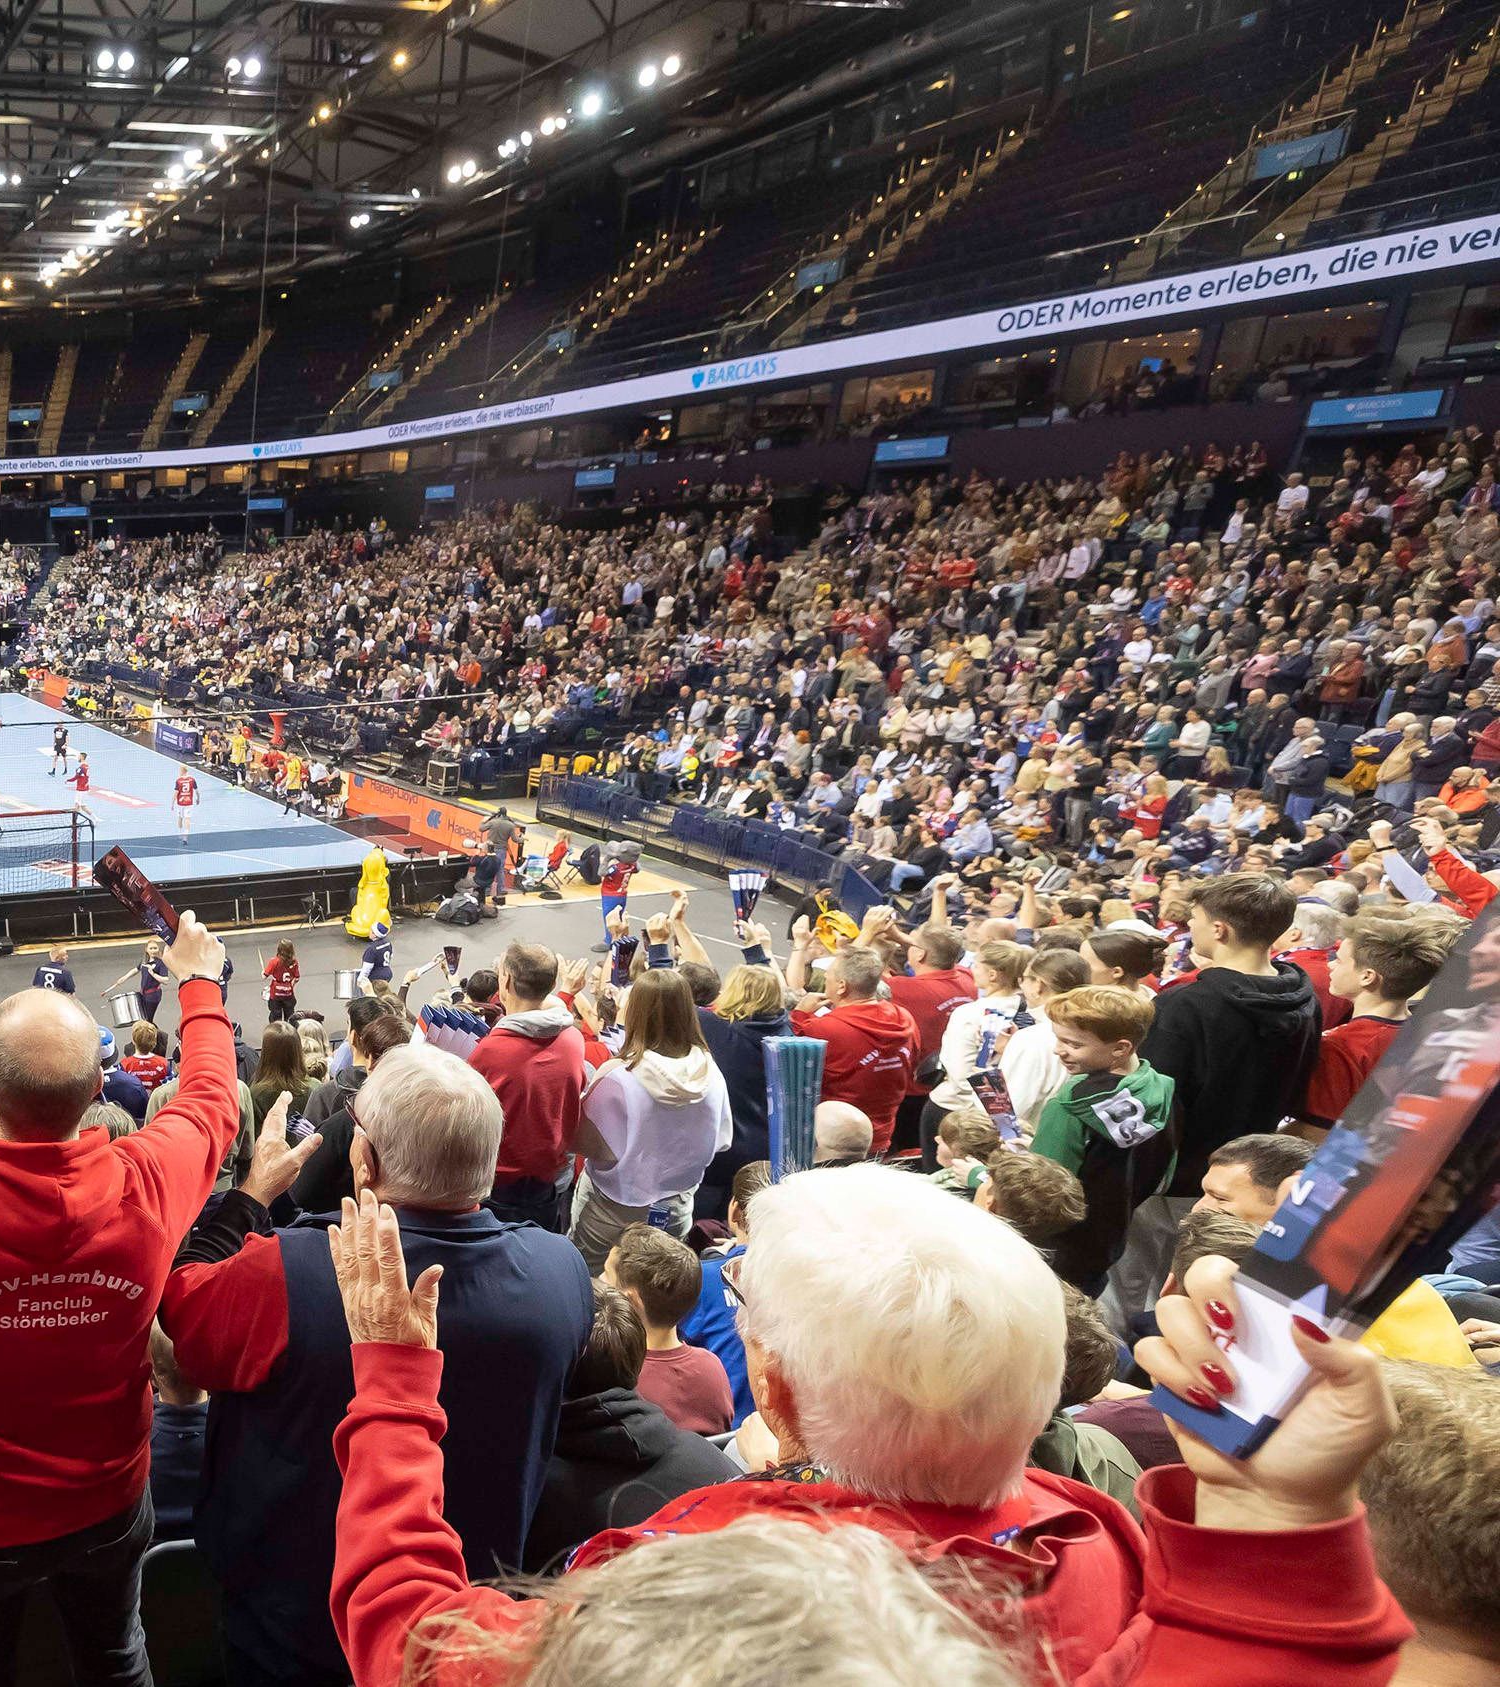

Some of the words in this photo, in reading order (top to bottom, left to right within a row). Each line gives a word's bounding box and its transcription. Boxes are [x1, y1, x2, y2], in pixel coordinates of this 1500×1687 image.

[998, 303, 1064, 333] ODER
[1069, 283, 1192, 321] Momente
[1200, 263, 1318, 298] erleben,
[1328, 246, 1377, 276] die
[1384, 235, 1438, 265] nie
[707, 356, 778, 385] BARCLAYS
[388, 425, 408, 438] ODER
[503, 398, 555, 418] verblassen?
[264, 442, 303, 456] BARCLAYS
[20, 459, 57, 469] erleben,
[59, 458, 74, 468] die
[75, 457, 89, 467] nie
[90, 454, 143, 466] verblassen?
[370, 780, 419, 805] Hapag-Lloyd
[17, 1295, 93, 1313] Fanclub
[0, 1310, 109, 1330] Störtebeker
